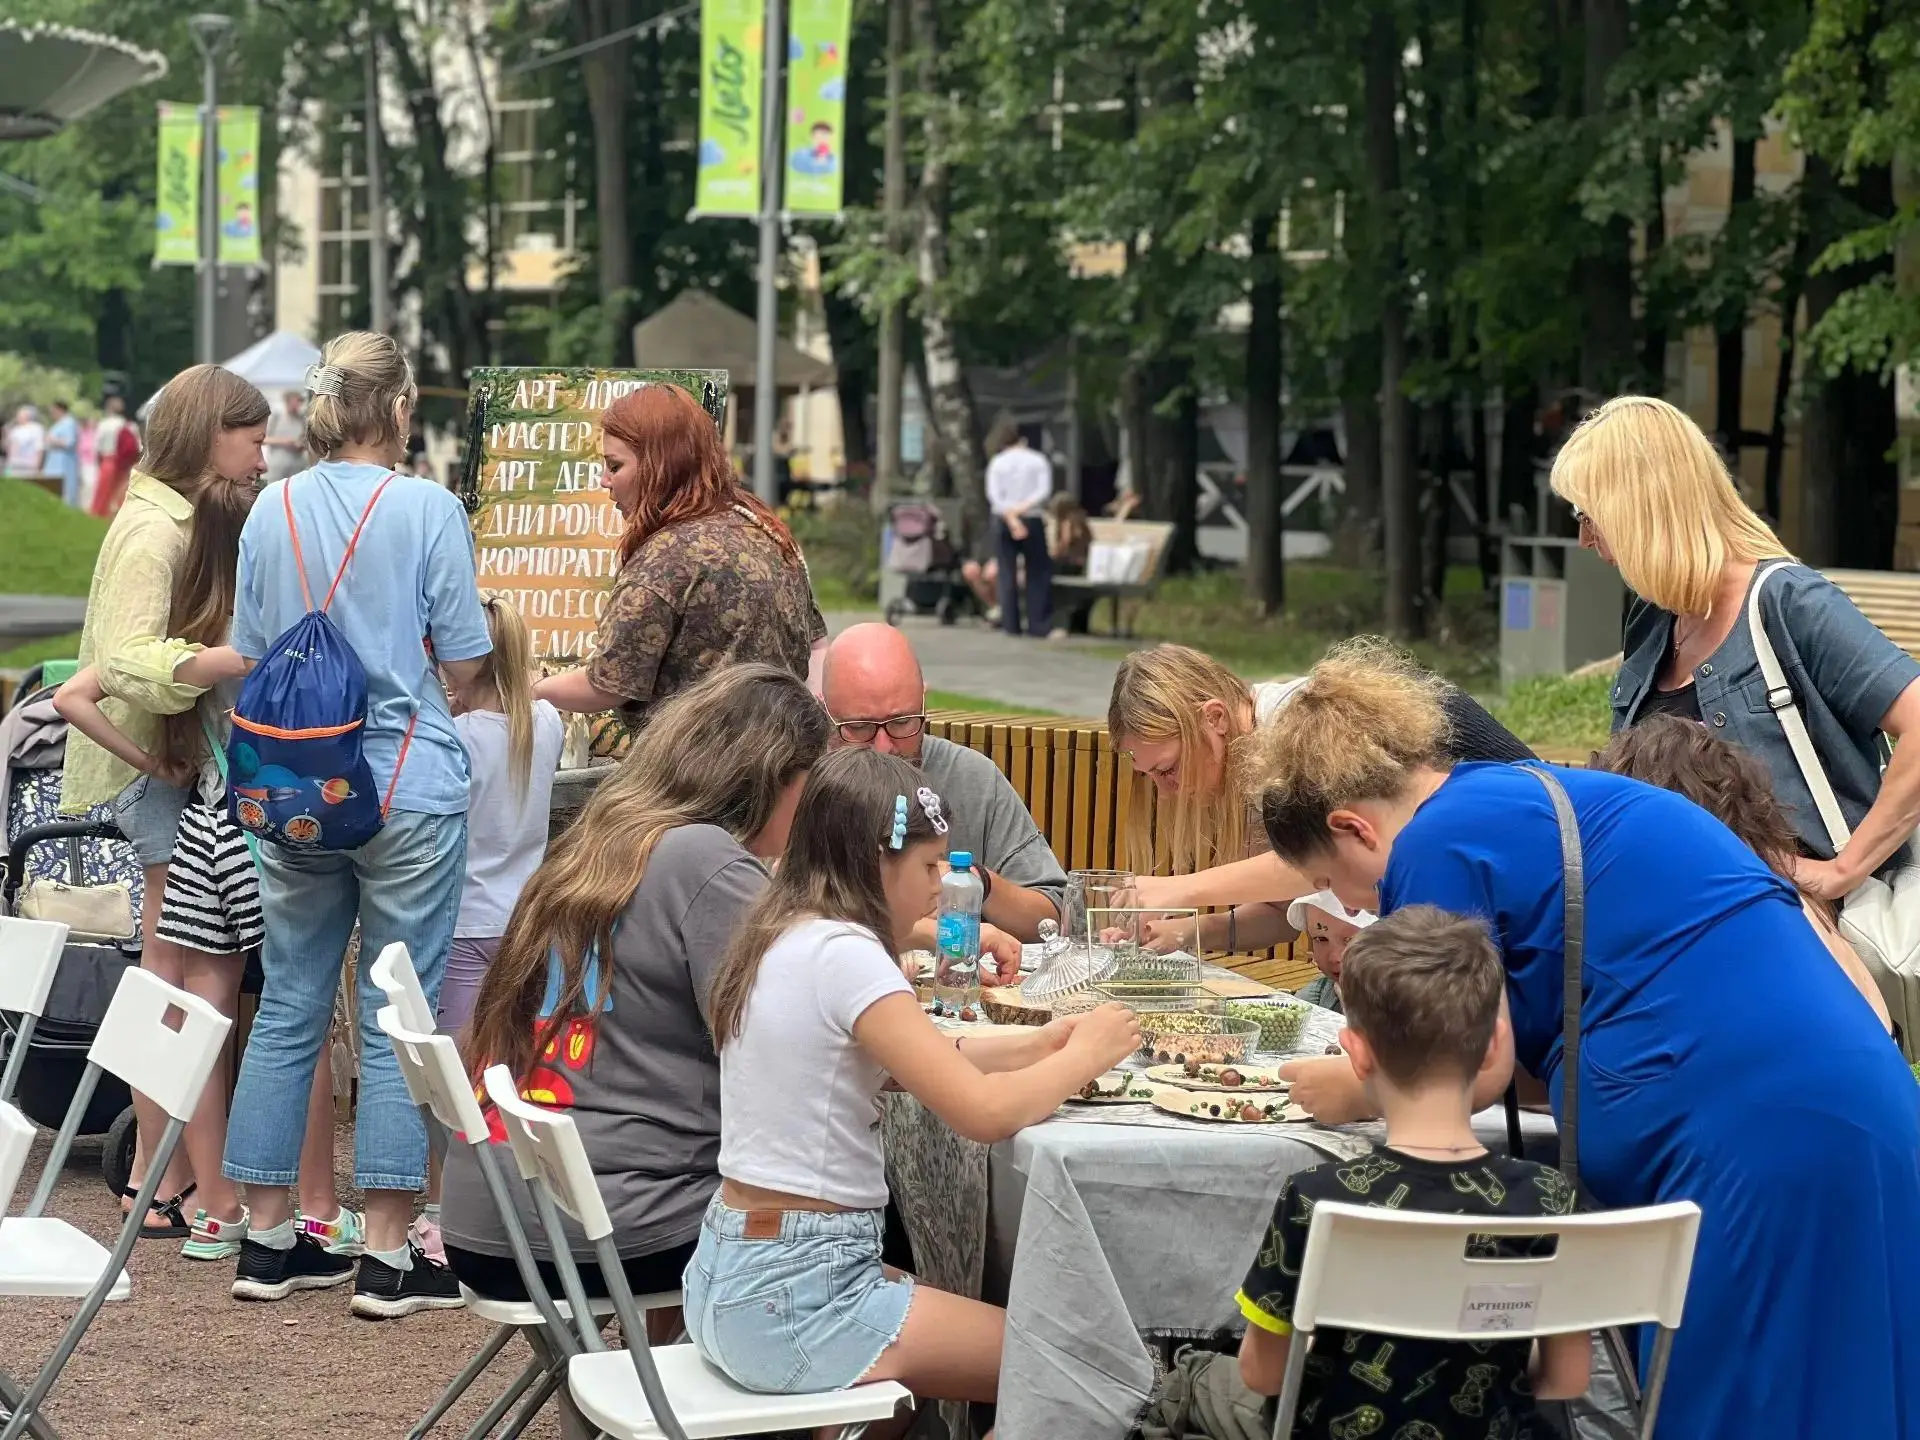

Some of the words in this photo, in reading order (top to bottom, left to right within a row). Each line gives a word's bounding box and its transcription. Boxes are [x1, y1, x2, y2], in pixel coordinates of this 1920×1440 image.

[511, 379, 561, 410] АРТ
[491, 421, 592, 451] МАСТЕР
[488, 460, 542, 492] АРТ
[482, 503, 545, 538] ДНИ
